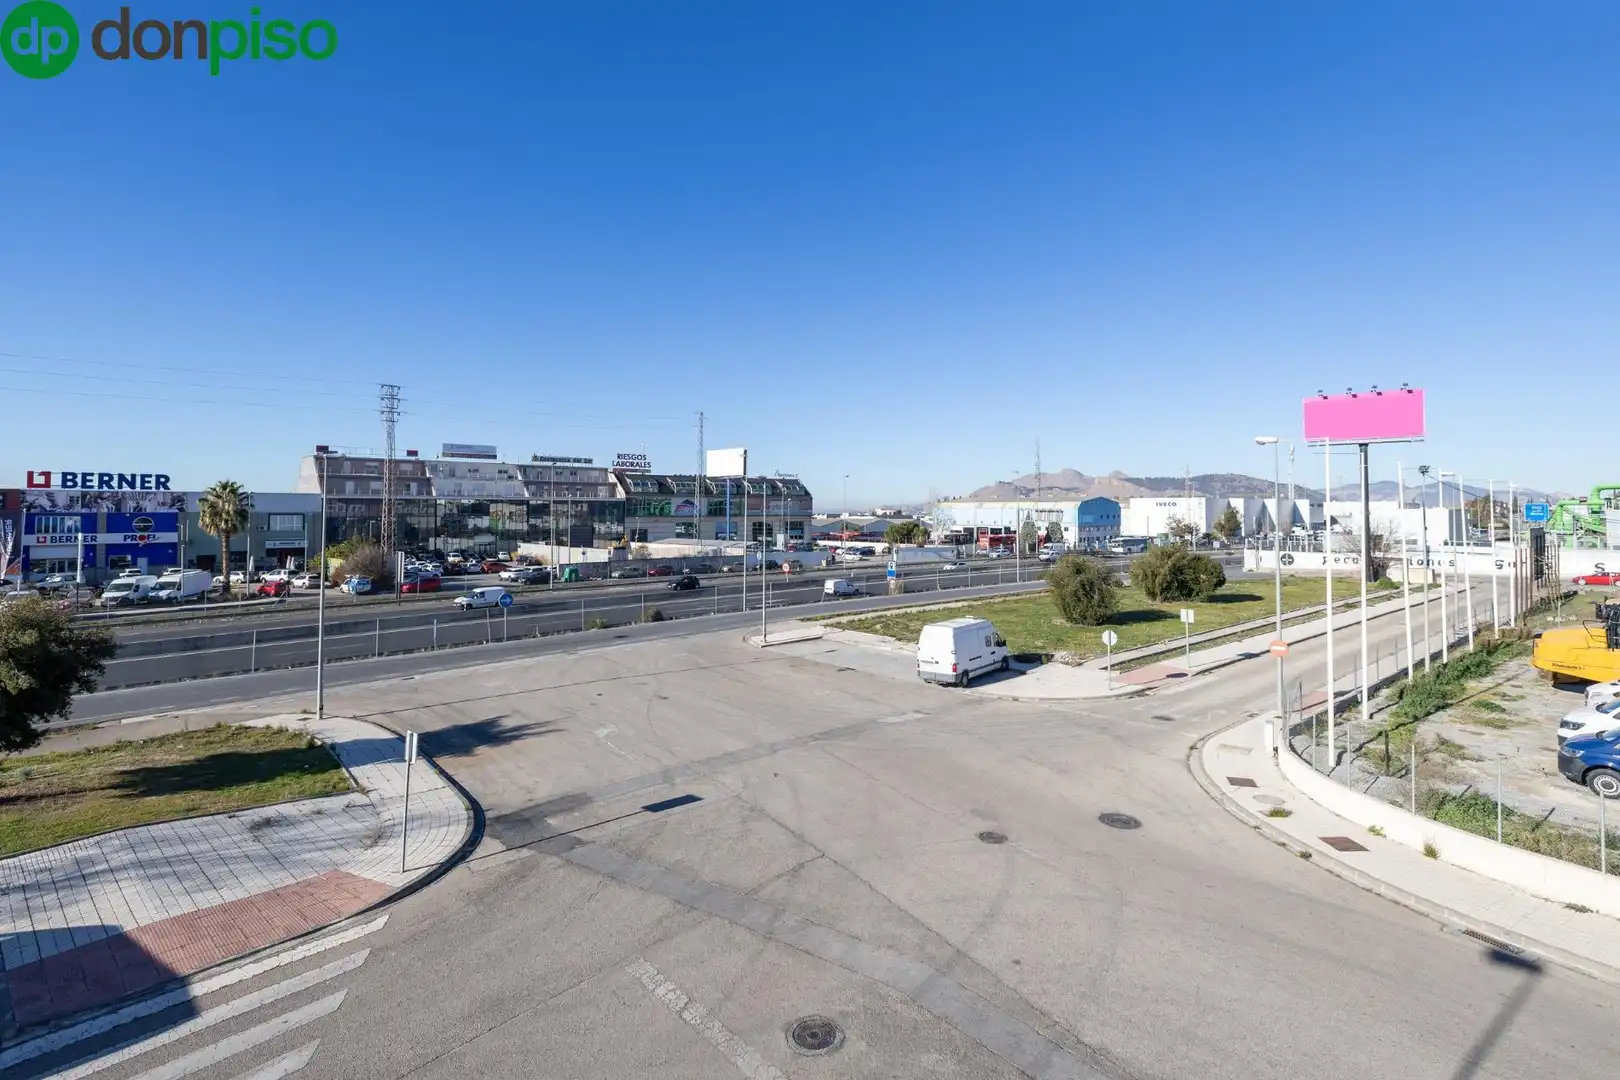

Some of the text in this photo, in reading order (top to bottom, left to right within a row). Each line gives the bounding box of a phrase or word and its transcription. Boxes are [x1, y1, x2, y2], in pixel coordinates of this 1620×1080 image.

[616, 453, 647, 461] RIESGOS
[612, 460, 652, 468] LABORALES
[61, 471, 171, 490] BERNER
[50, 534, 98, 544] BERNER
